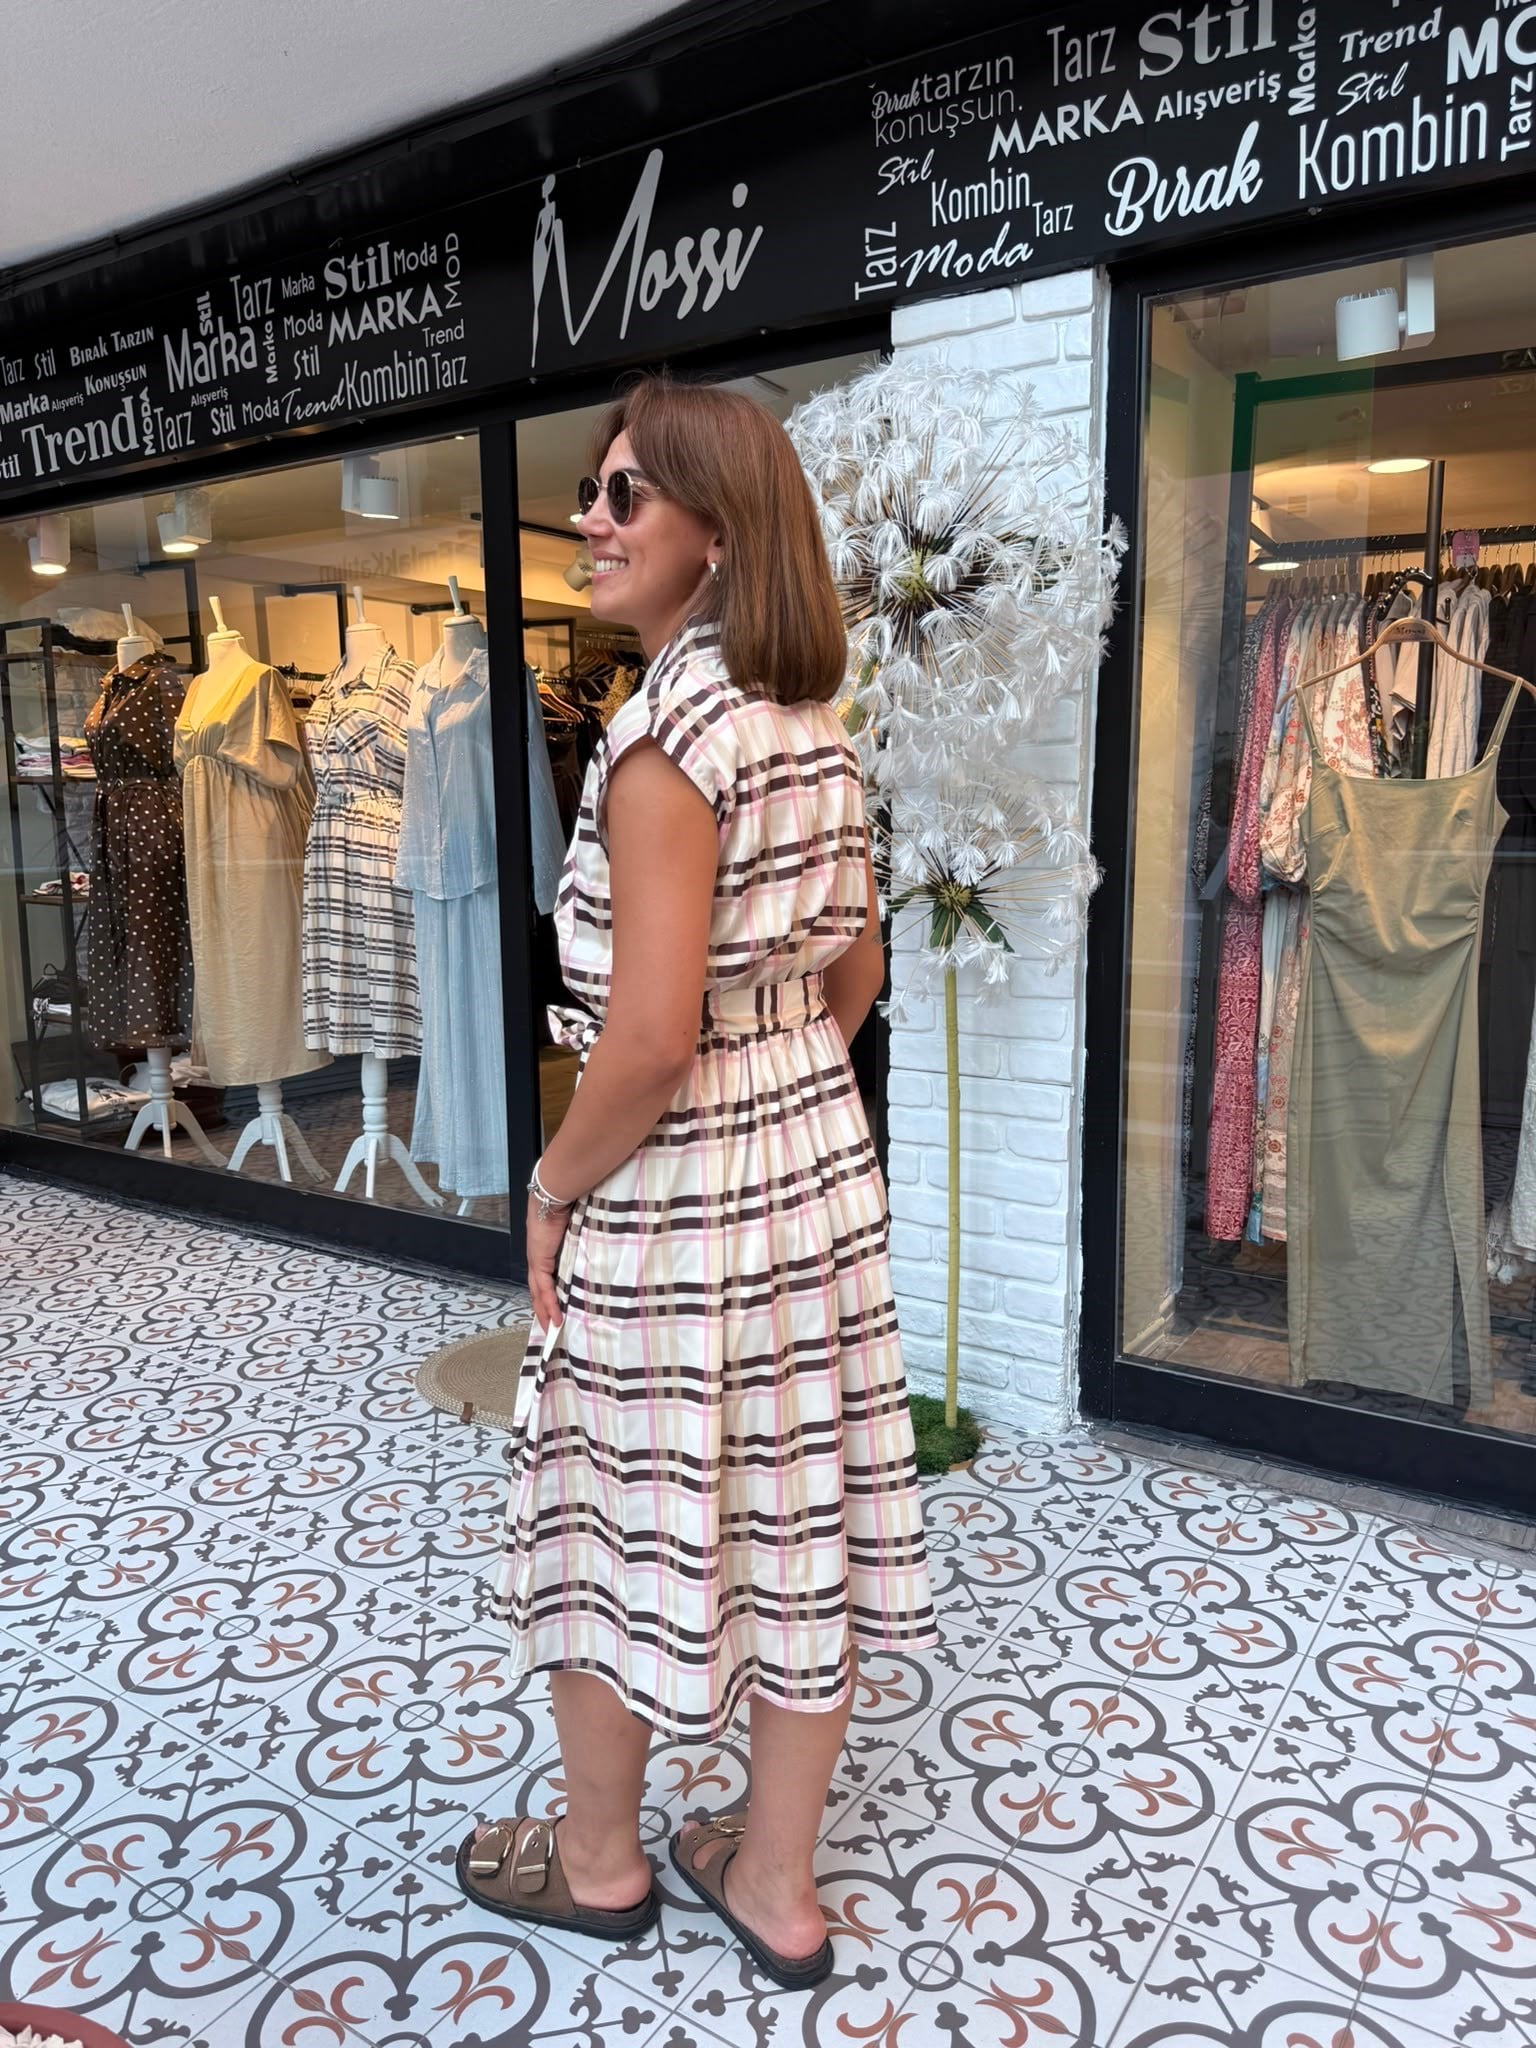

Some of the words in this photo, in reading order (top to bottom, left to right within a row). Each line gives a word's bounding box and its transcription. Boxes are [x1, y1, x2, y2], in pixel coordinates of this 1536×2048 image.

[1047, 25, 1116, 87] Tarz
[1138, 0, 1276, 80] Stil
[1288, 8, 1315, 116] Marka
[1339, 6, 1443, 63] Trend
[921, 55, 1014, 103] tarzın
[1155, 70, 1281, 122] Alışveriş
[1336, 61, 1409, 116] Stil
[875, 89, 1023, 148] konuşsun.
[987, 89, 1145, 163] MARKA
[1501, 71, 1533, 162] Tarz
[877, 149, 935, 195] Stil
[1299, 94, 1487, 200] Kombin
[931, 167, 1030, 228] Kombin
[1104, 120, 1263, 236] Bırak
[1032, 201, 1074, 237] Tarz
[323, 241, 392, 301] Stil
[393, 242, 437, 276] Moda
[444, 232, 462, 310] MOD
[532, 149, 763, 368] Mossi
[855, 221, 897, 301] Tarz
[900, 221, 1034, 288] Moda
[229, 275, 275, 324] Tarz
[281, 272, 315, 299] Marka
[283, 309, 323, 340] Moda
[328, 283, 443, 348] MARKA
[422, 318, 465, 348] Trend
[0, 356, 25, 386] Tarz
[34, 348, 56, 380] Stil
[163, 316, 258, 393] Marka
[262, 320, 278, 384] Marka
[293, 345, 320, 380] Stil
[345, 350, 429, 410] Kombin
[431, 352, 468, 389] Tarz
[0, 393, 50, 425] Marka
[51, 392, 84, 412] Alışveriş
[139, 386, 156, 456] MODA
[191, 386, 229, 408] Alışveriş
[211, 404, 236, 436] Stil
[242, 396, 279, 426] Moda
[281, 378, 346, 424] Trend
[21, 395, 140, 477] Trend
[154, 407, 195, 452] Tarz
[0, 454, 21, 479] til
